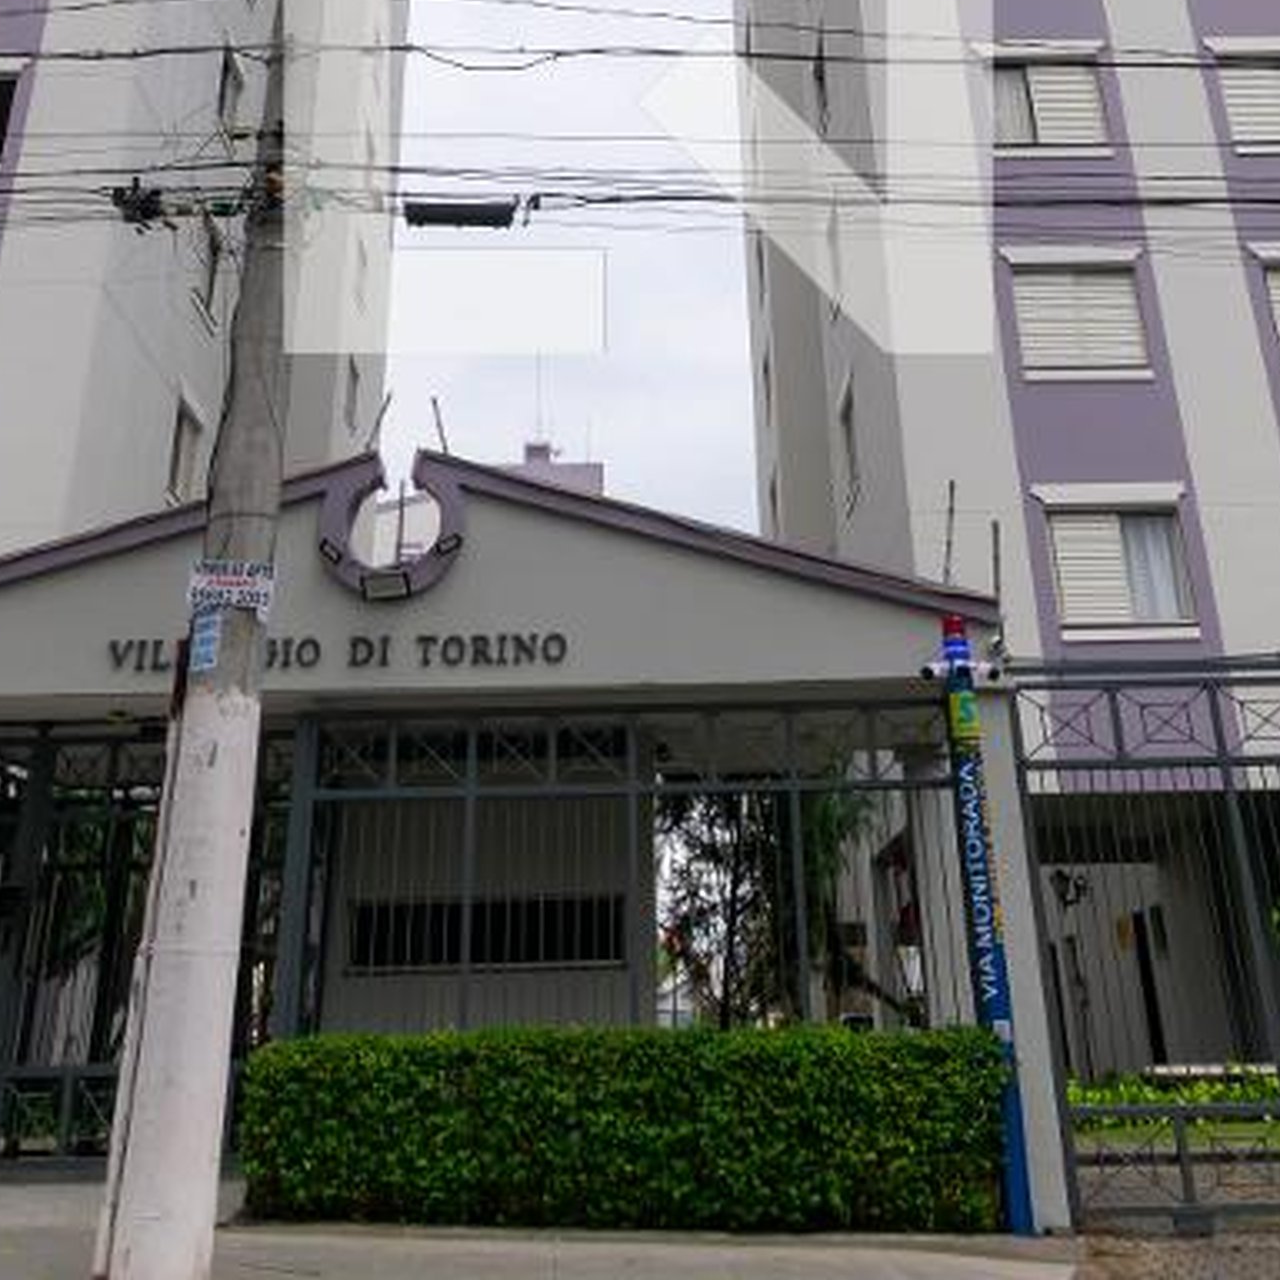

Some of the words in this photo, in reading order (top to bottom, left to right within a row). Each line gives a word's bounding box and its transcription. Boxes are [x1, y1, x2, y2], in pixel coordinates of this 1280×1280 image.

[347, 636, 390, 668] DI
[416, 631, 570, 668] TORINO
[958, 760, 996, 950] MONITORADA
[980, 953, 1000, 1002] VIA
